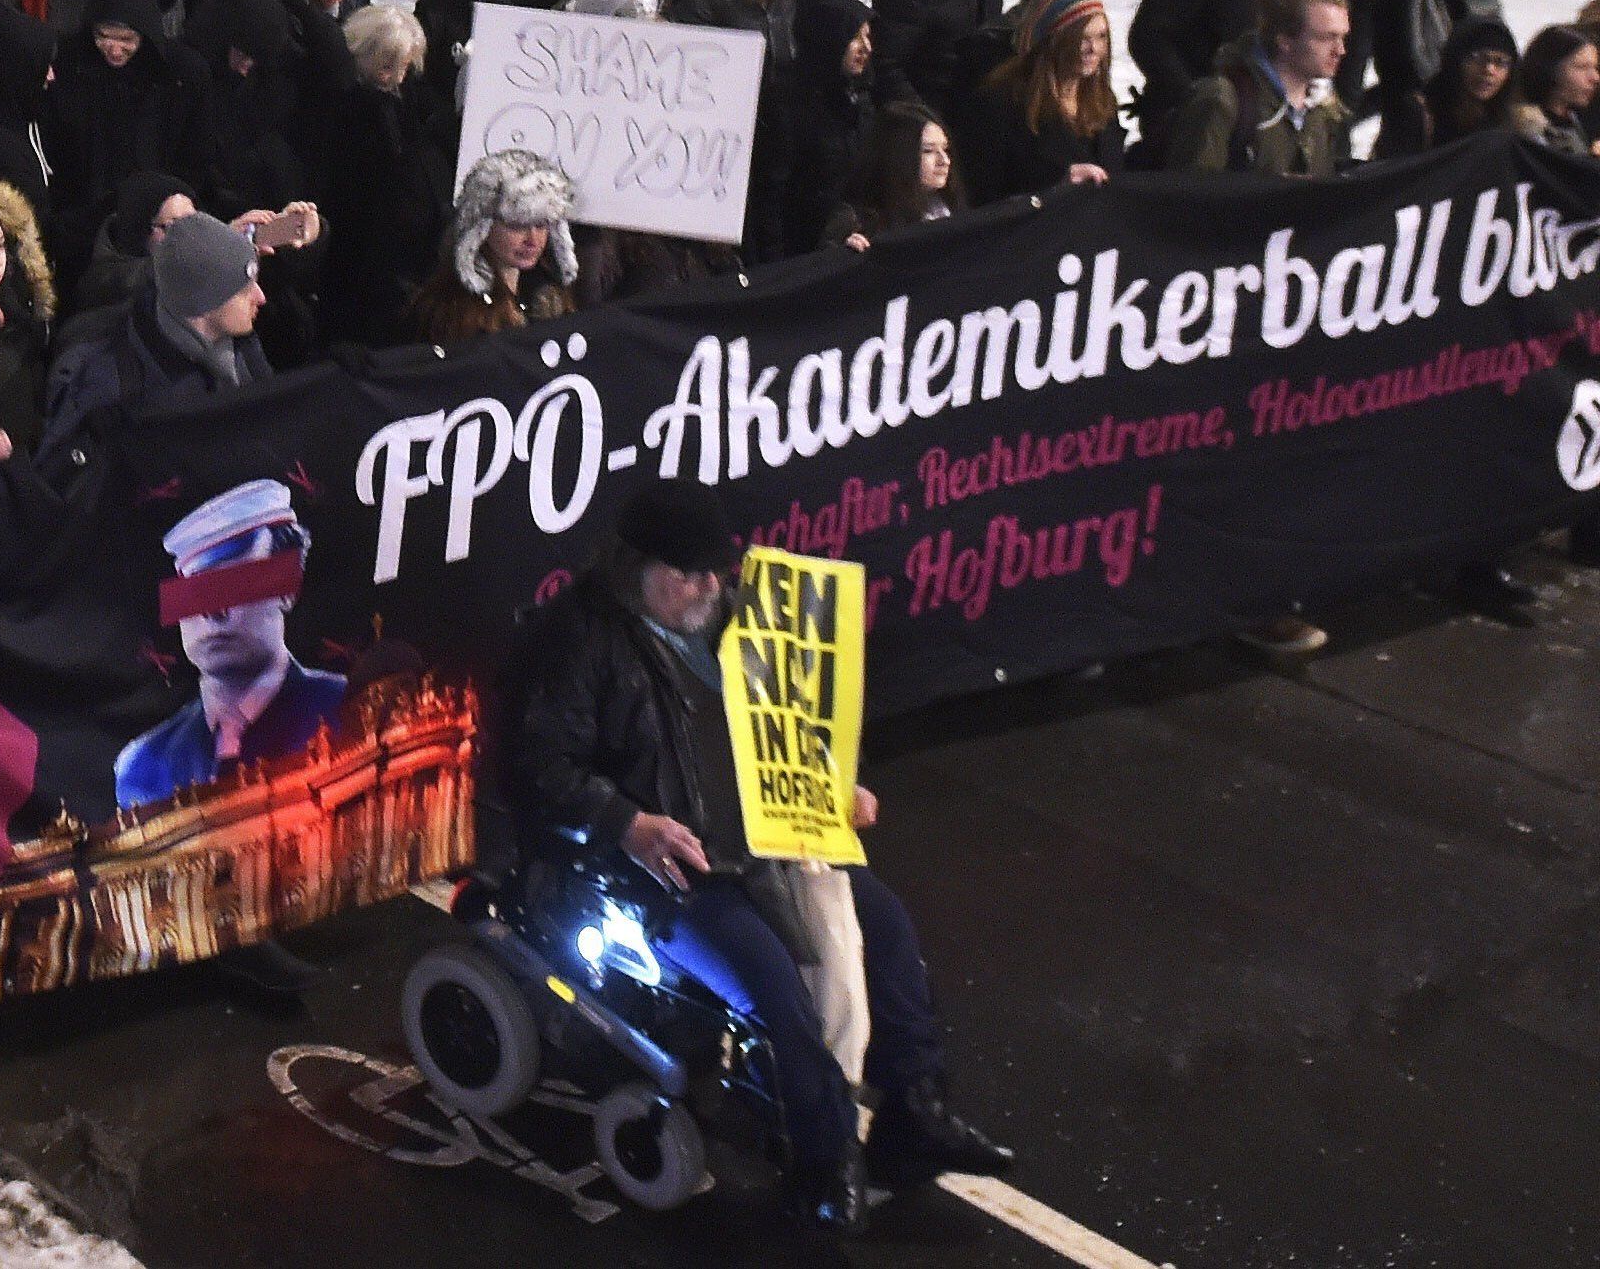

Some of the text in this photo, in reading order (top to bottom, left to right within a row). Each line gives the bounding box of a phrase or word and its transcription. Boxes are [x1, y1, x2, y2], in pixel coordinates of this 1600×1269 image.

[505, 19, 729, 111] SHAME
[483, 102, 742, 202] ON YOU!
[918, 406, 1235, 510] Rechtsextreme,
[905, 483, 1163, 621] Hofburg!
[750, 711, 788, 763] IN
